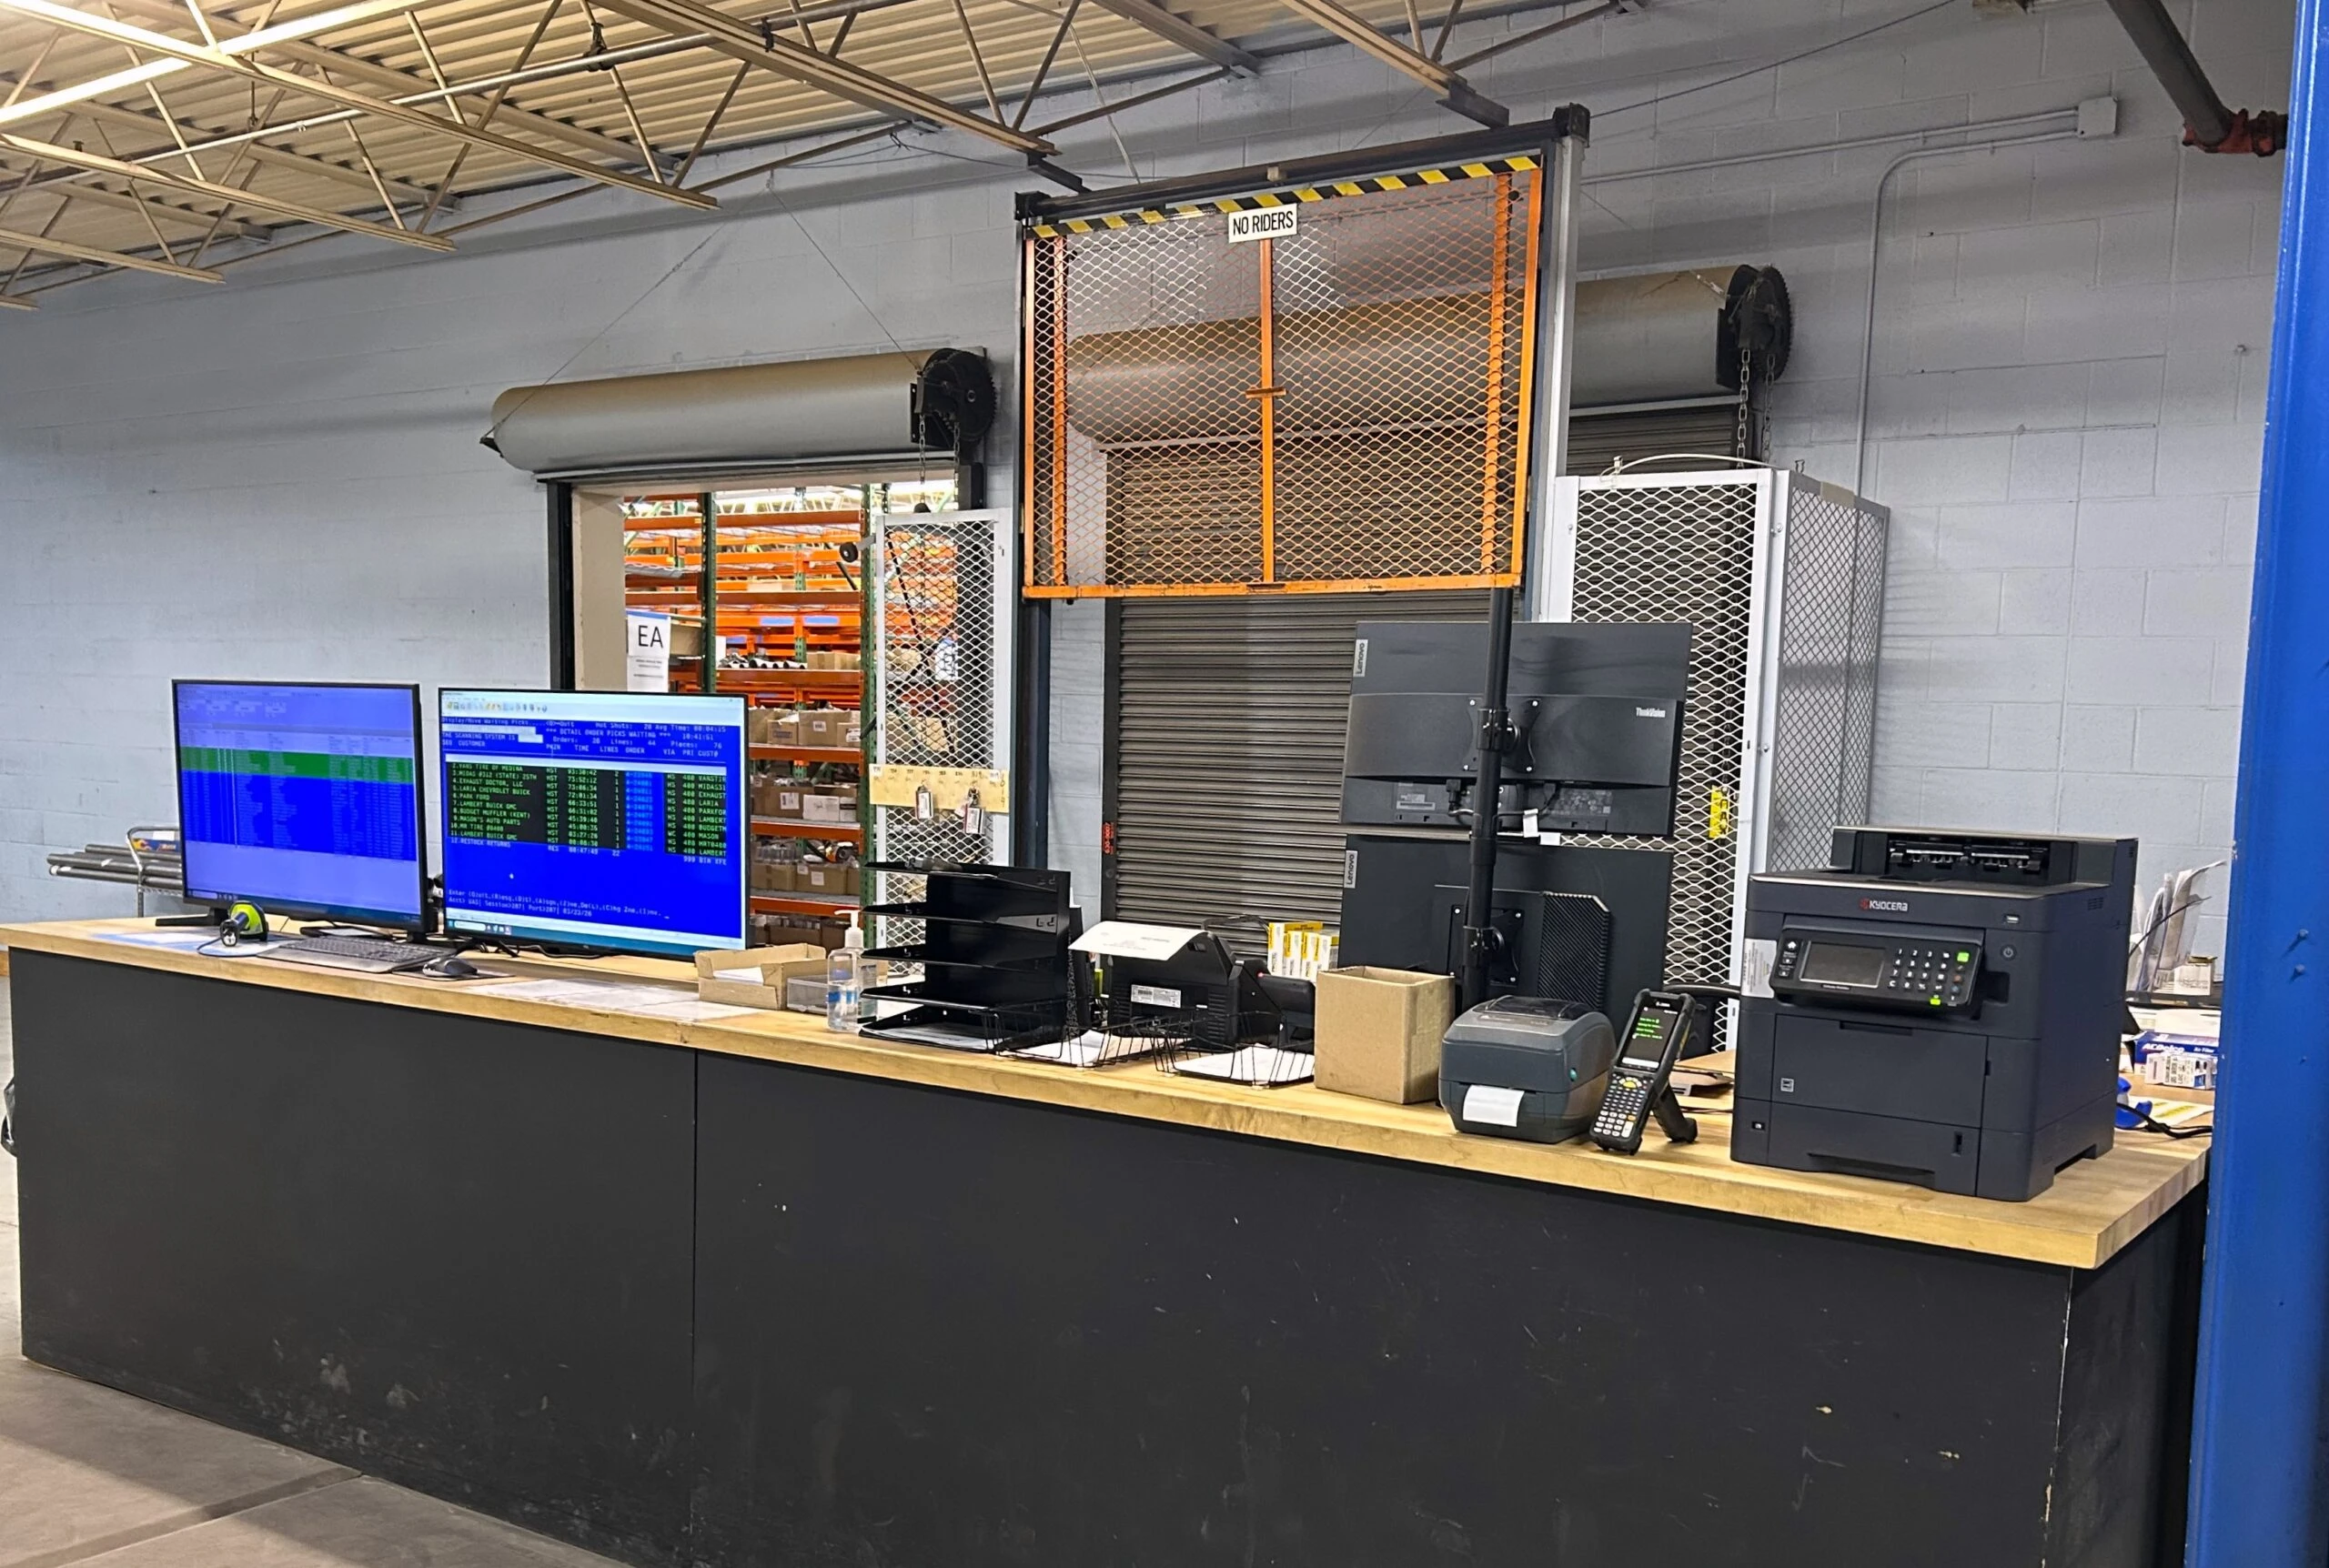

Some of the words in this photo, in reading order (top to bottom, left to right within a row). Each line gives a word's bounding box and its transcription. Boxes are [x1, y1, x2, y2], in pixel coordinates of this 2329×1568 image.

[1234, 216, 1249, 236] NO
[1252, 210, 1294, 233] RIDERS
[638, 624, 663, 648] EA
[1356, 642, 1365, 675] Lenovo
[629, 730, 656, 739] WAITING
[1346, 854, 1355, 884] Lenovo
[449, 889, 466, 898] Enter
[1869, 900, 1909, 911] KYOCERA
